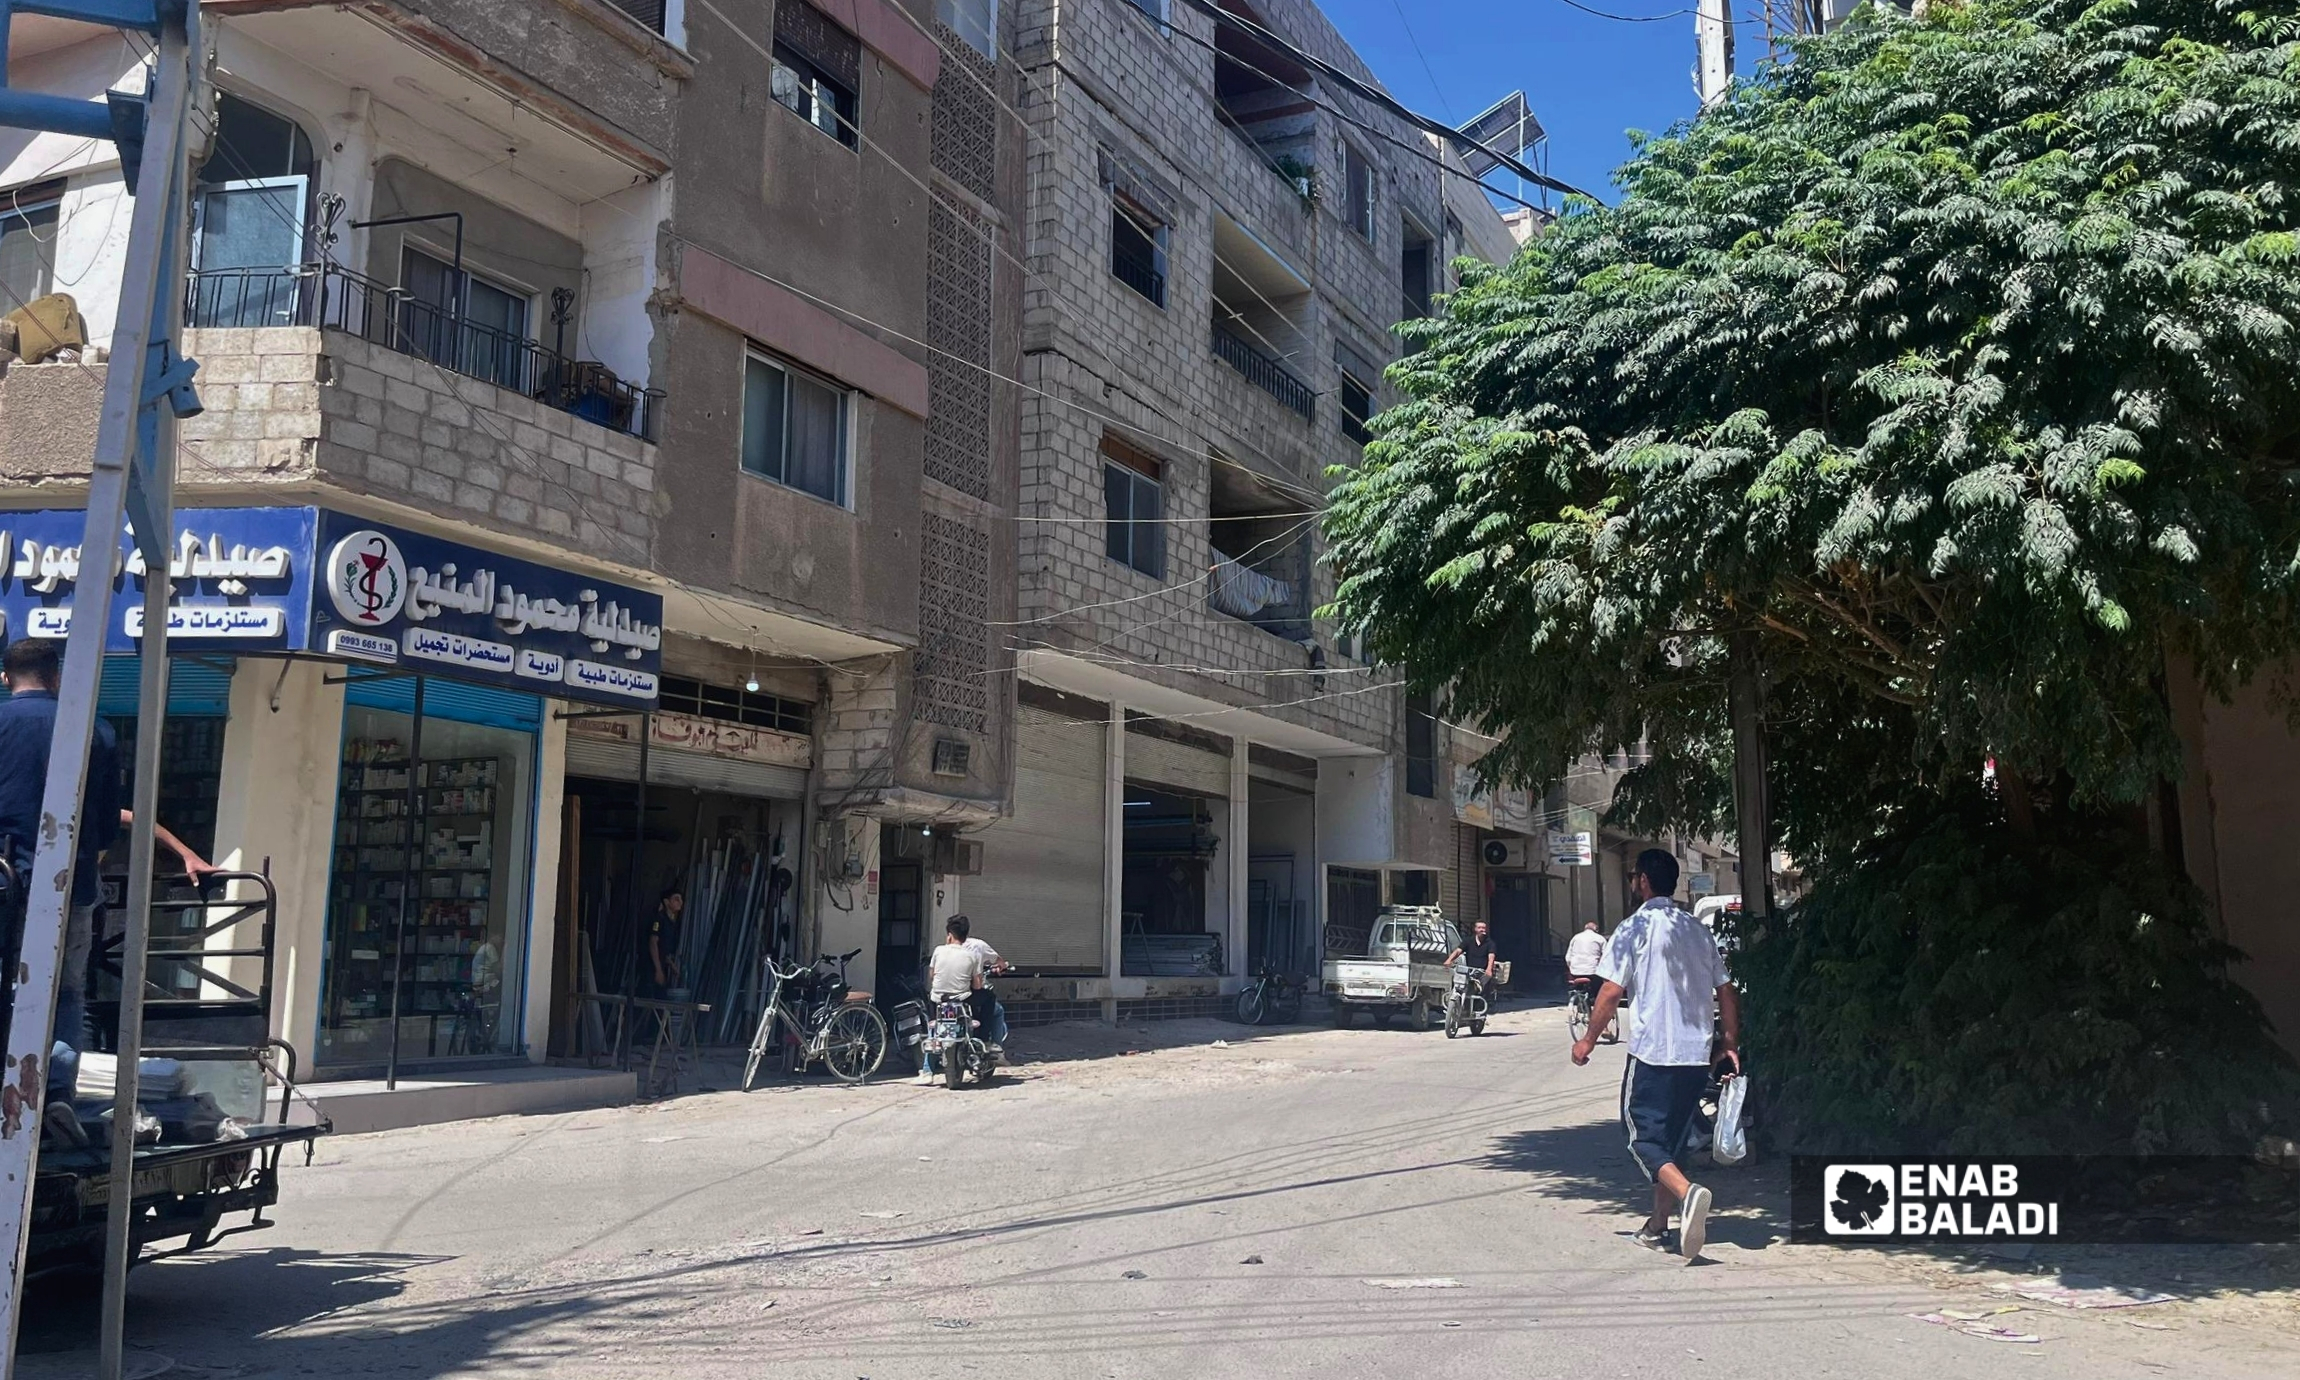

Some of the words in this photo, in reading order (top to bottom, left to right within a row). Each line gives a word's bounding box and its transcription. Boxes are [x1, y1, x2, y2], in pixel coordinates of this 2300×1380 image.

[124, 520, 291, 596] صيدلة
[404, 562, 495, 621] المنيع
[495, 584, 580, 635] محمود
[189, 611, 268, 632] مستلزمات
[579, 589, 661, 660] صيدلية
[340, 635, 360, 646] 0993
[362, 639, 376, 650] 665
[379, 643, 393, 653] 138
[414, 633, 450, 656] تجميل
[453, 639, 511, 664] مستحضرات
[528, 653, 559, 675] أدوية
[578, 663, 607, 685] طبية
[609, 670, 653, 691] مستلزمات
